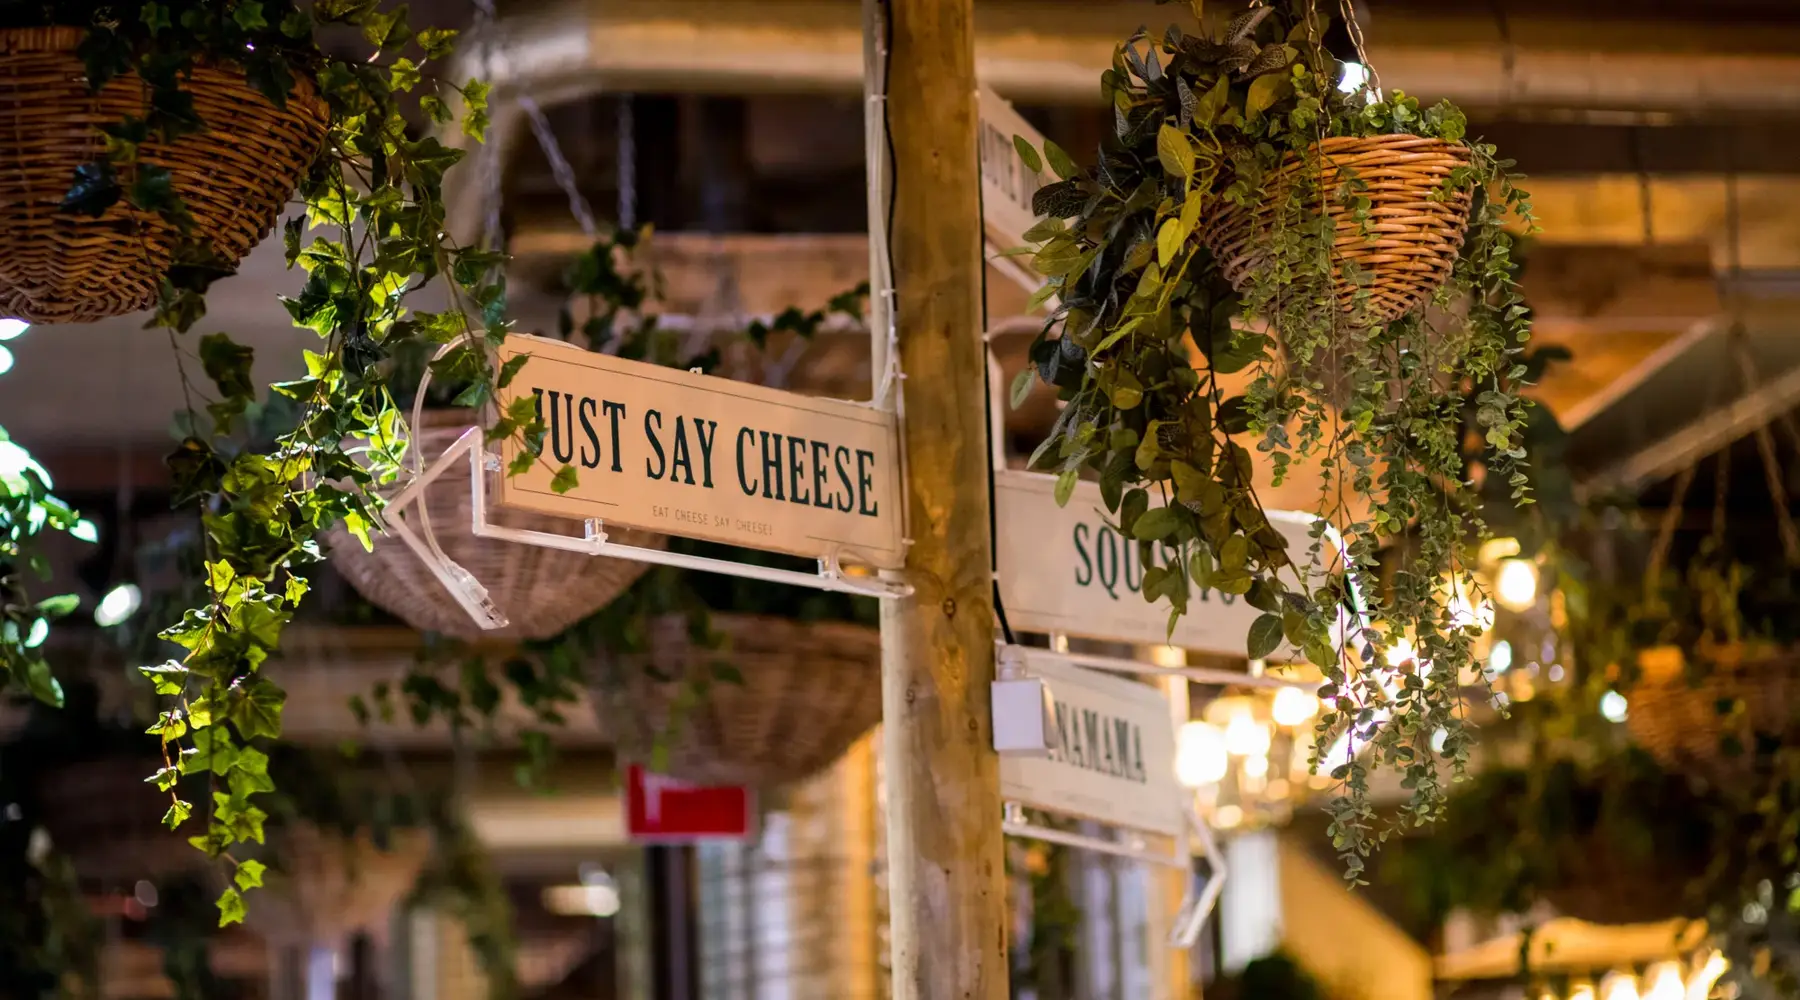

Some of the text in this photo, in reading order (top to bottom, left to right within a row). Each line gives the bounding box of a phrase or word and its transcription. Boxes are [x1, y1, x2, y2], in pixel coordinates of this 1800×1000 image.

[531, 387, 878, 517] JUST SAY CHEESE
[652, 505, 773, 536] EAT CHEESE SAY CHEESE!
